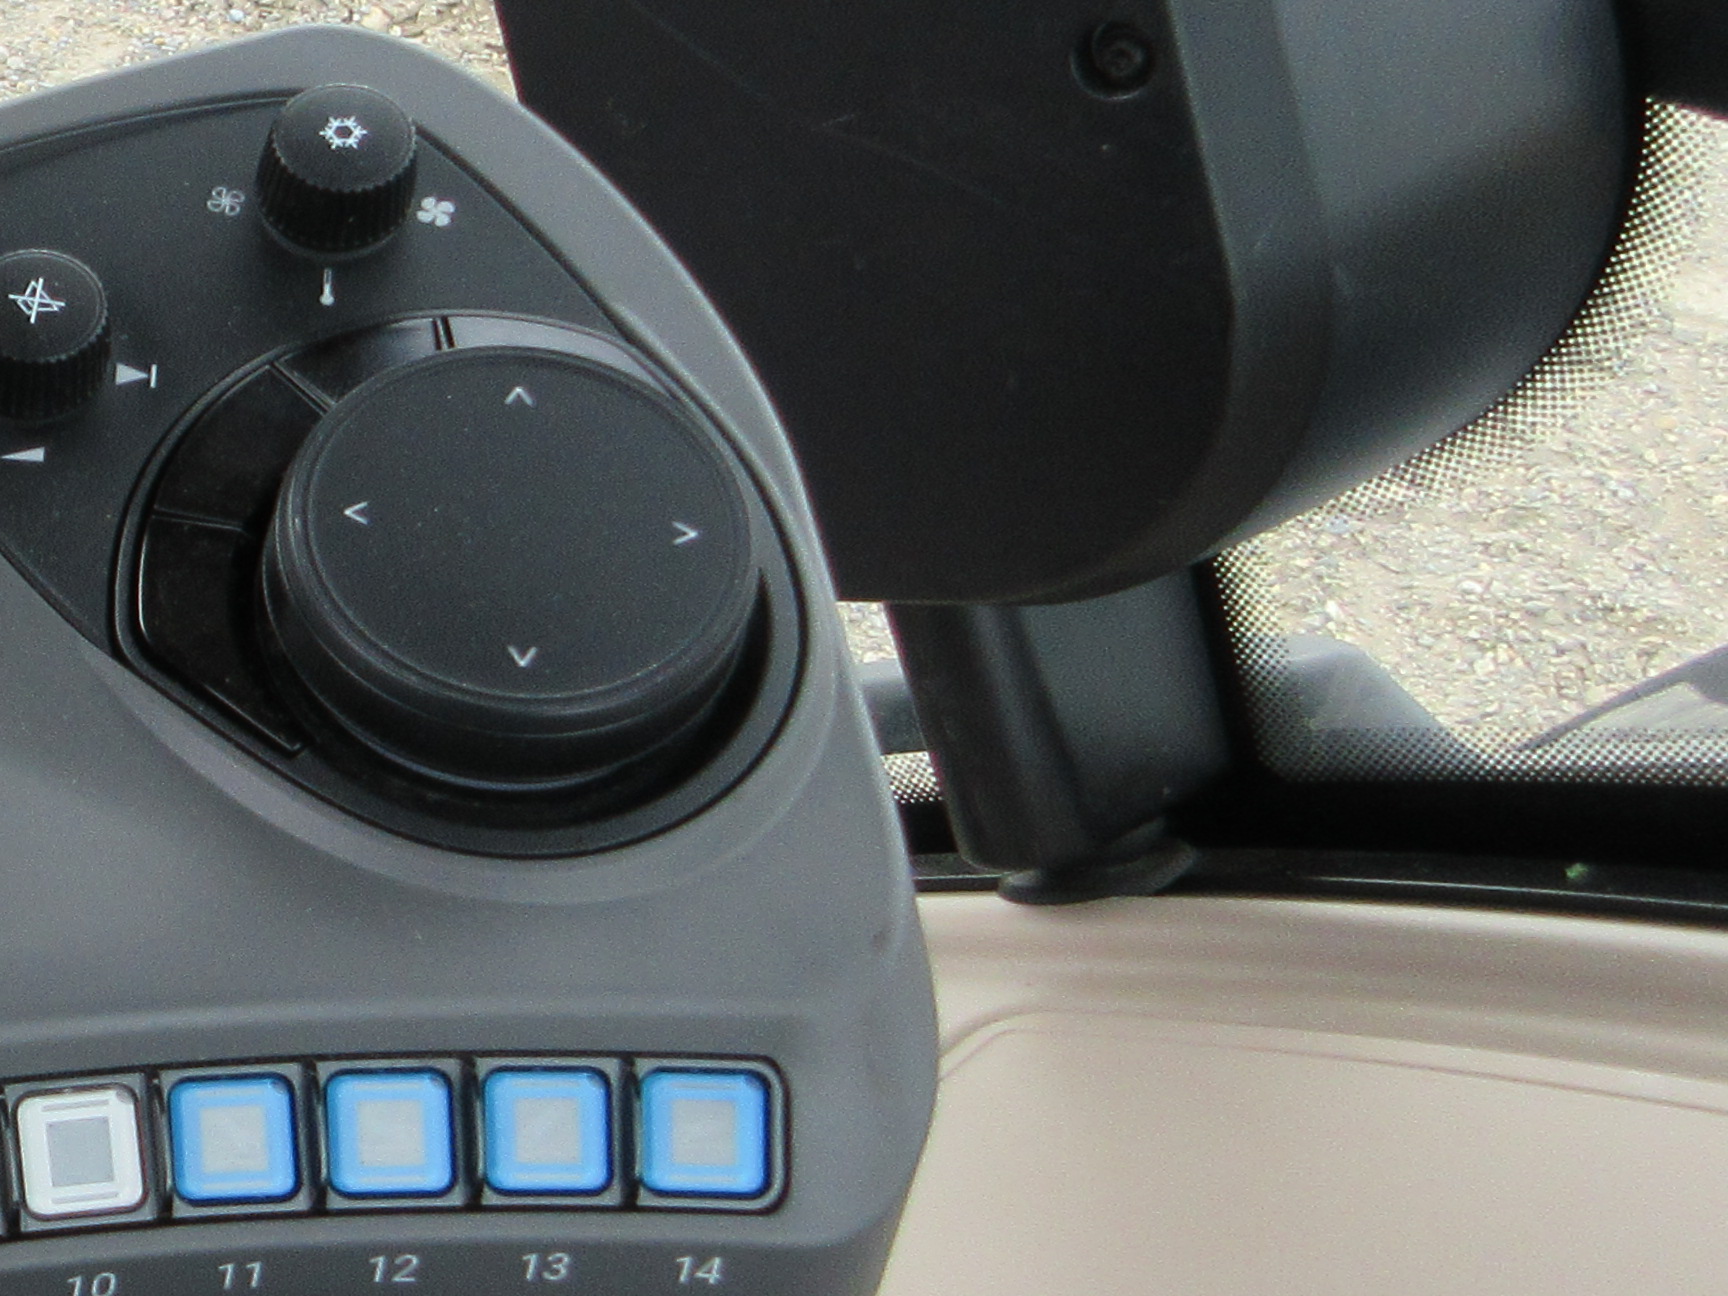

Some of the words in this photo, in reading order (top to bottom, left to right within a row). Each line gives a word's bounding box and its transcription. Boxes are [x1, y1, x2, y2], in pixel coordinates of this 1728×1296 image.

[218, 1262, 262, 1288] 11
[368, 1254, 420, 1283] 12
[521, 1252, 570, 1281] 13
[675, 1256, 723, 1284] 14
